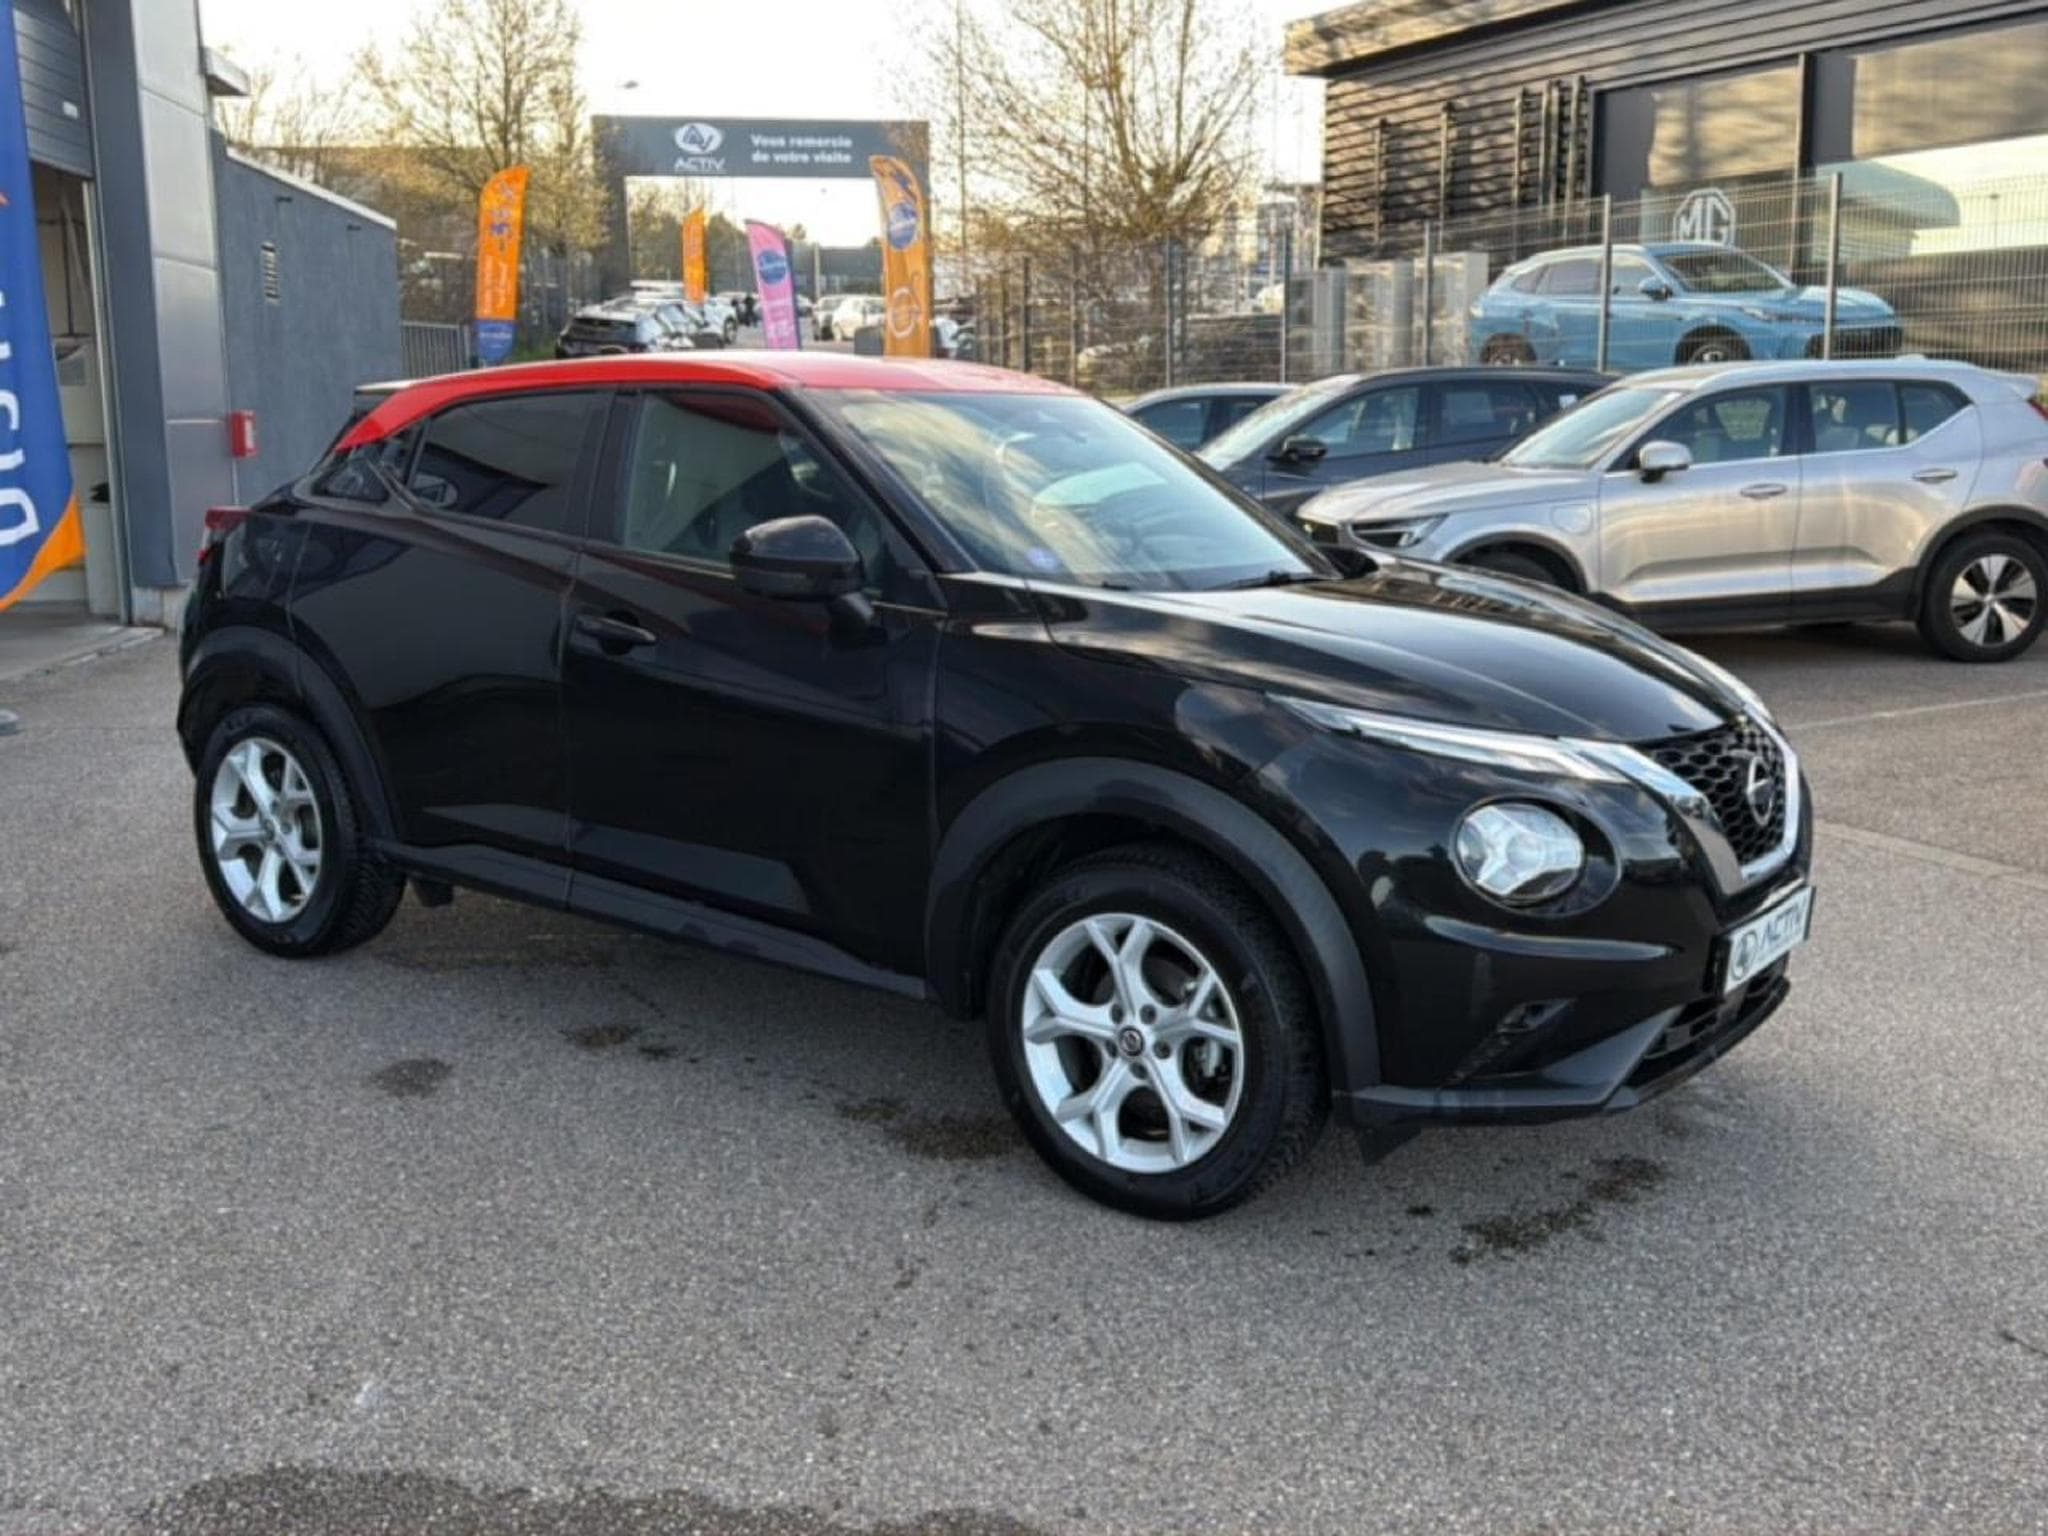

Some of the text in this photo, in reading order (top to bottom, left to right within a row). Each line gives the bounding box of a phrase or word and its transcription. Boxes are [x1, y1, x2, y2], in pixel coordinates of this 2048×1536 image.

[751, 134, 852, 147] Vous remercie
[752, 149, 851, 162] de votre visite
[674, 157, 725, 172] ACTIV
[1679, 195, 1730, 246] MG
